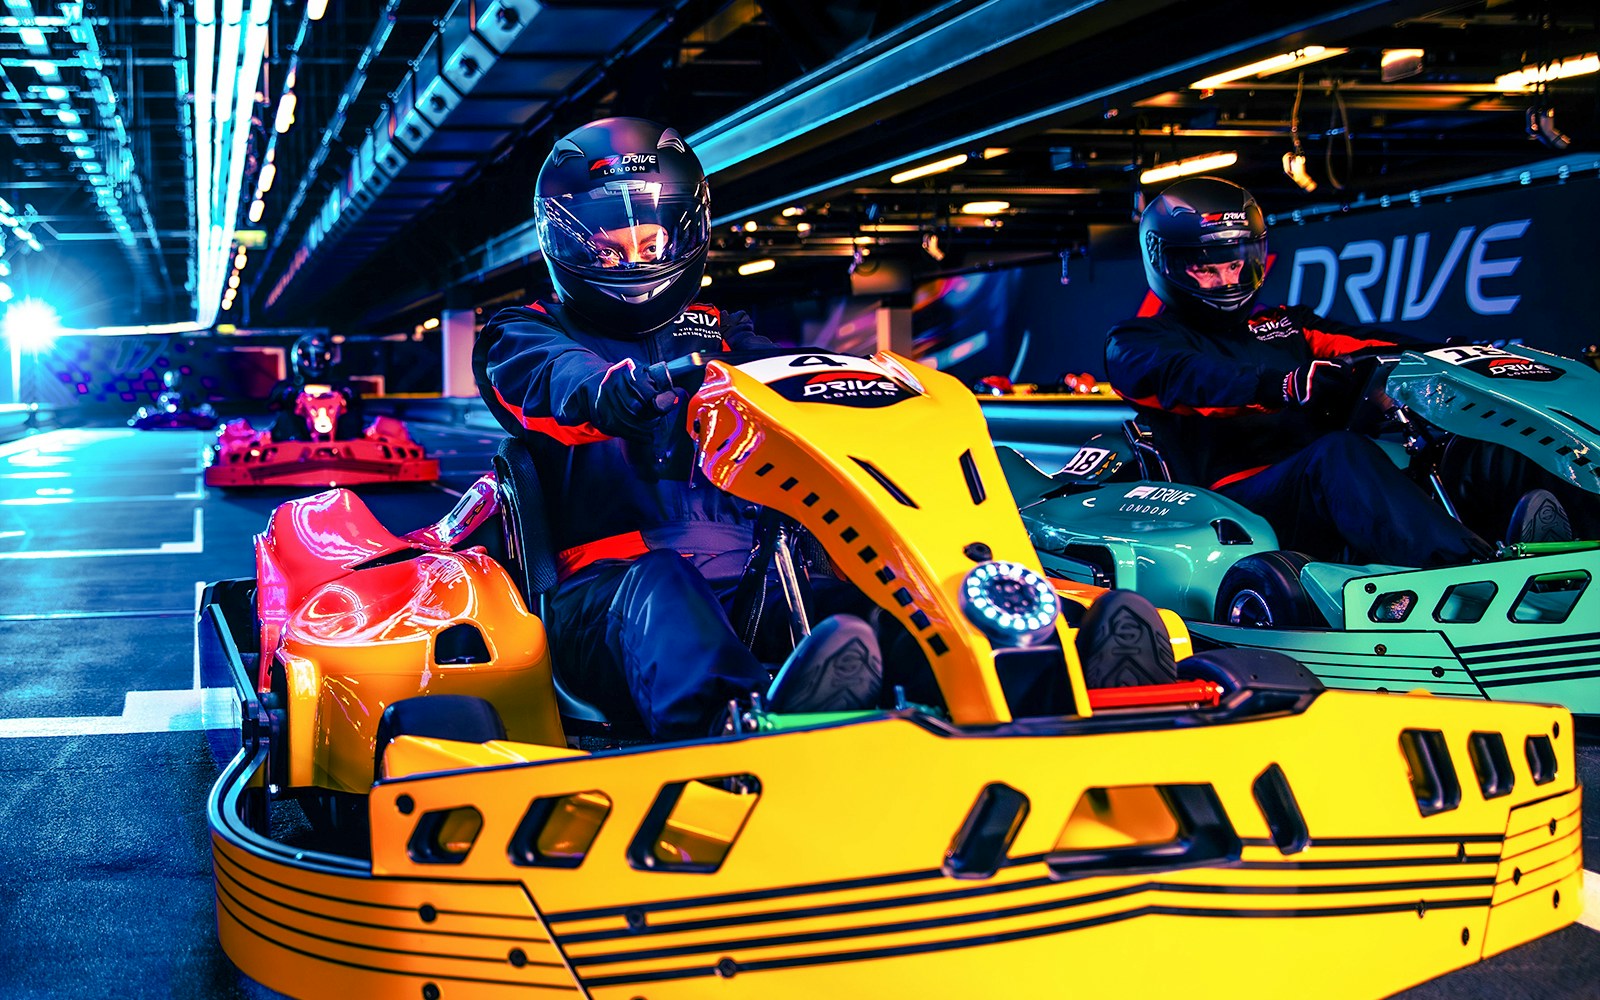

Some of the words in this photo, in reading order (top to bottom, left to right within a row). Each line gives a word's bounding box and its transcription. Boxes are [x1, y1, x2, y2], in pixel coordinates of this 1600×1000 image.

[621, 153, 657, 165] DRIVE
[603, 165, 646, 175] LONDON
[1223, 211, 1246, 221] DRIVE
[1287, 219, 1532, 323] DRIVE
[673, 311, 718, 327] RIV
[788, 355, 847, 367] 4
[1489, 364, 1551, 375] DRIVE
[803, 380, 899, 397] DRIVE
[822, 391, 896, 400] LONDON
[1065, 449, 1101, 472] 18
[1152, 488, 1197, 505] DRIVE
[1119, 504, 1170, 516] LONDON
